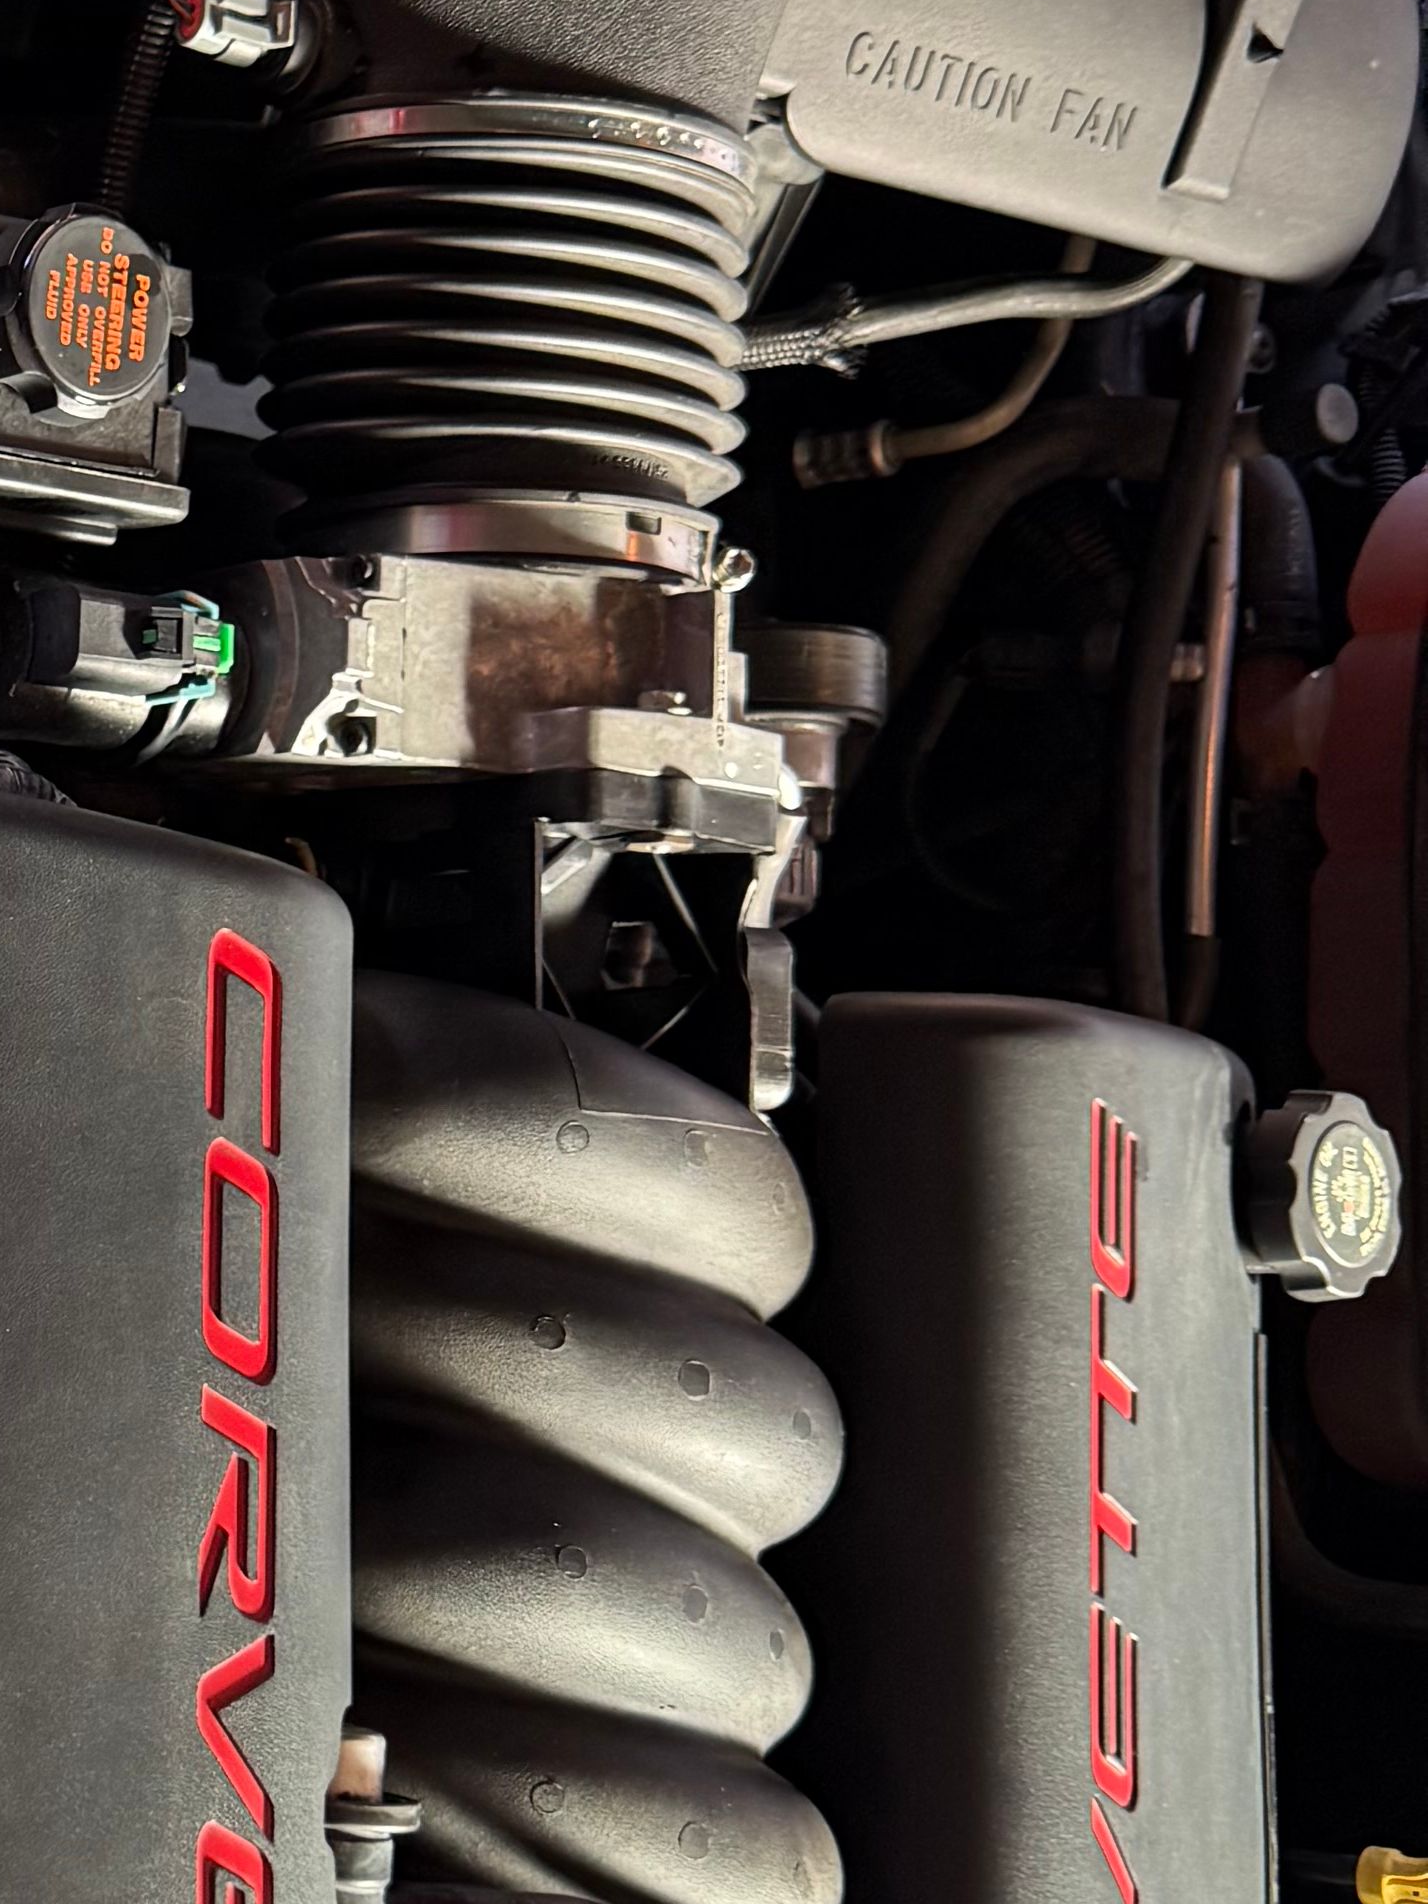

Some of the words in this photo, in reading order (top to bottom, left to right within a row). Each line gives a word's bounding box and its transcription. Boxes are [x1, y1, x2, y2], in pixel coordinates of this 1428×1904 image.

[844, 31, 1031, 129] CAUTION
[1031, 89, 1138, 154] FAN
[101, 227, 114, 253] DO
[46, 270, 60, 320] FLUID
[60, 253, 78, 346] APPROVED
[80, 259, 94, 294] USE
[98, 261, 111, 297] NOT
[77, 304, 90, 348] ONLY
[104, 254, 129, 370] STEERING
[129, 274, 150, 362] POWER
[89, 306, 105, 386] OVERFILL
